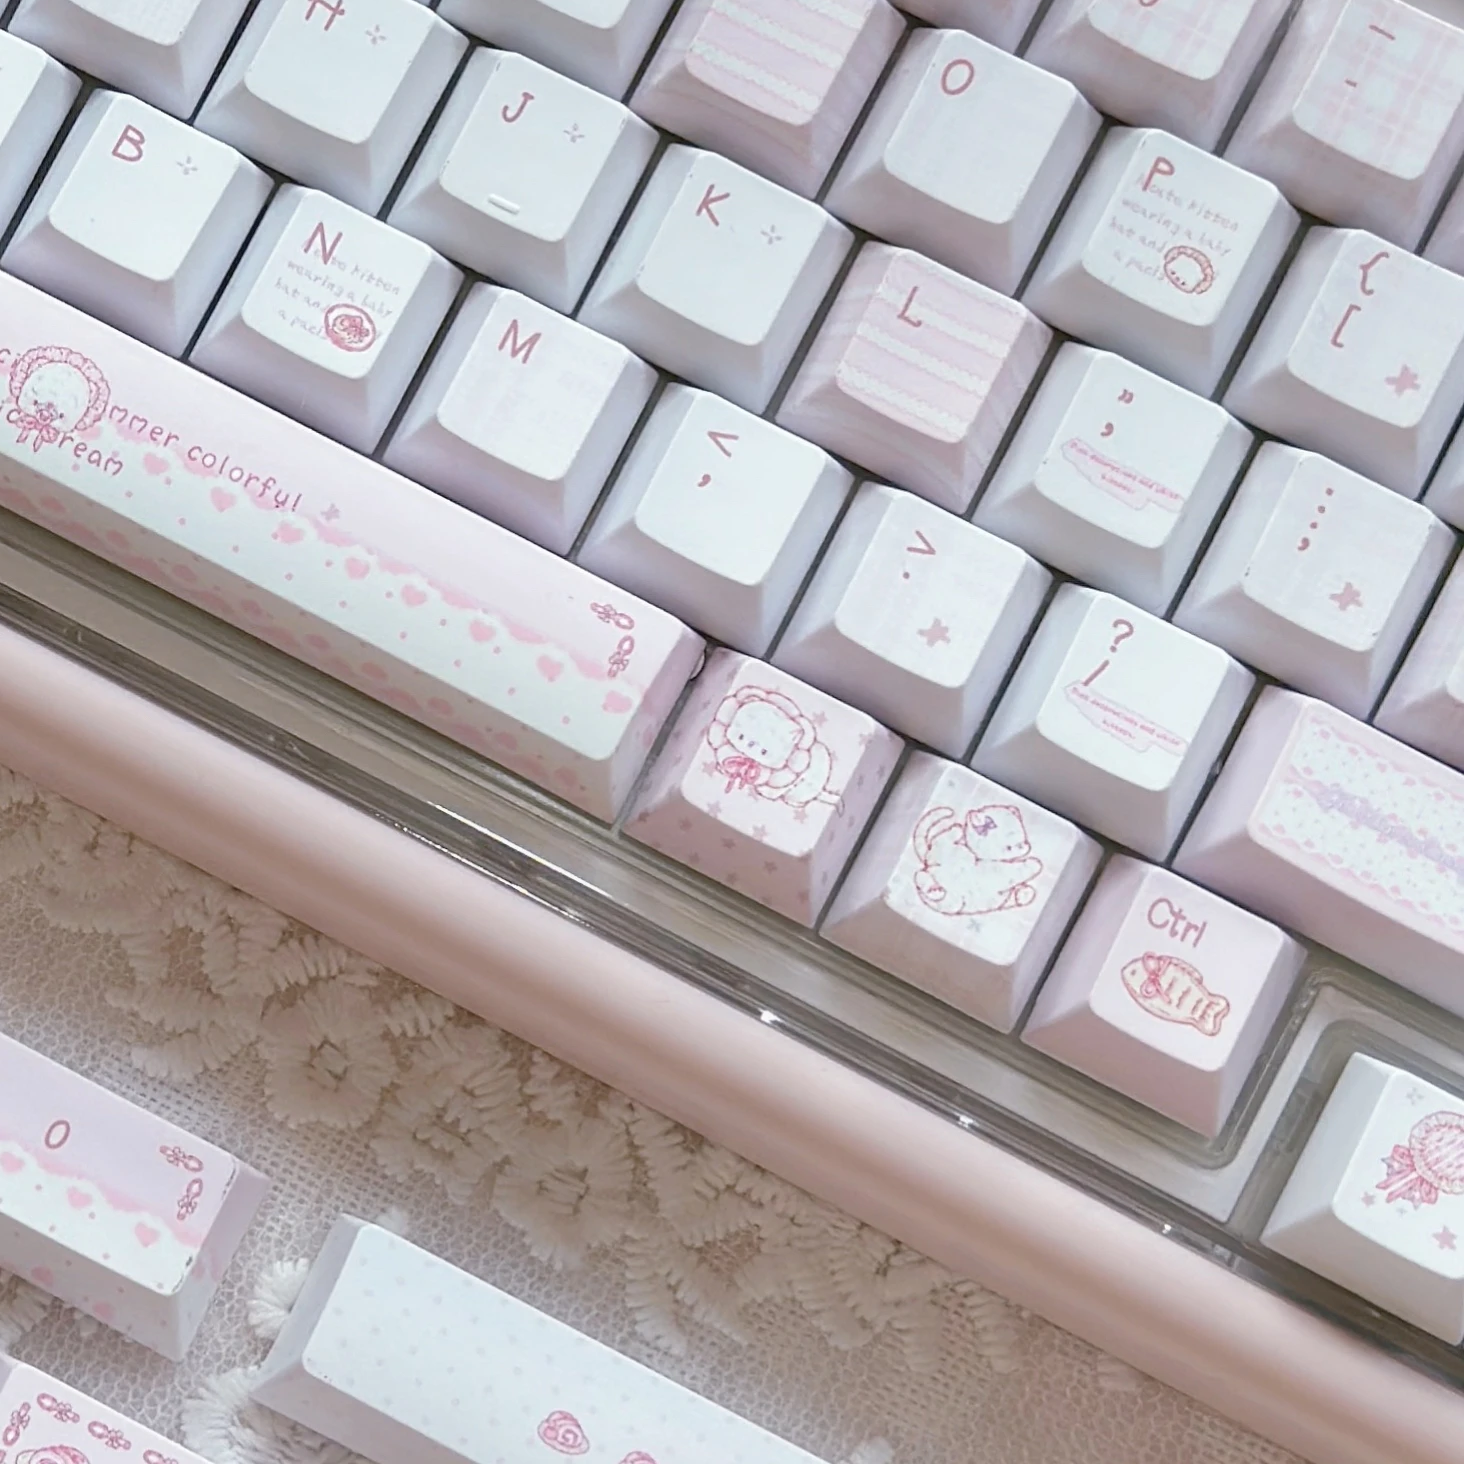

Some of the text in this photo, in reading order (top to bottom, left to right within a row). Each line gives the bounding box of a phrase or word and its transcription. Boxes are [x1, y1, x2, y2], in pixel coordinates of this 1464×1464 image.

[940, 59, 976, 96] O
[501, 93, 534, 124] J
[111, 125, 146, 162] B
[1142, 156, 1175, 191] P
[695, 183, 730, 226] K
[303, 221, 343, 265] N
[897, 286, 922, 329] L
[498, 319, 541, 364] M
[1110, 618, 1134, 653] ?
[1147, 897, 1207, 949] Ctrl
